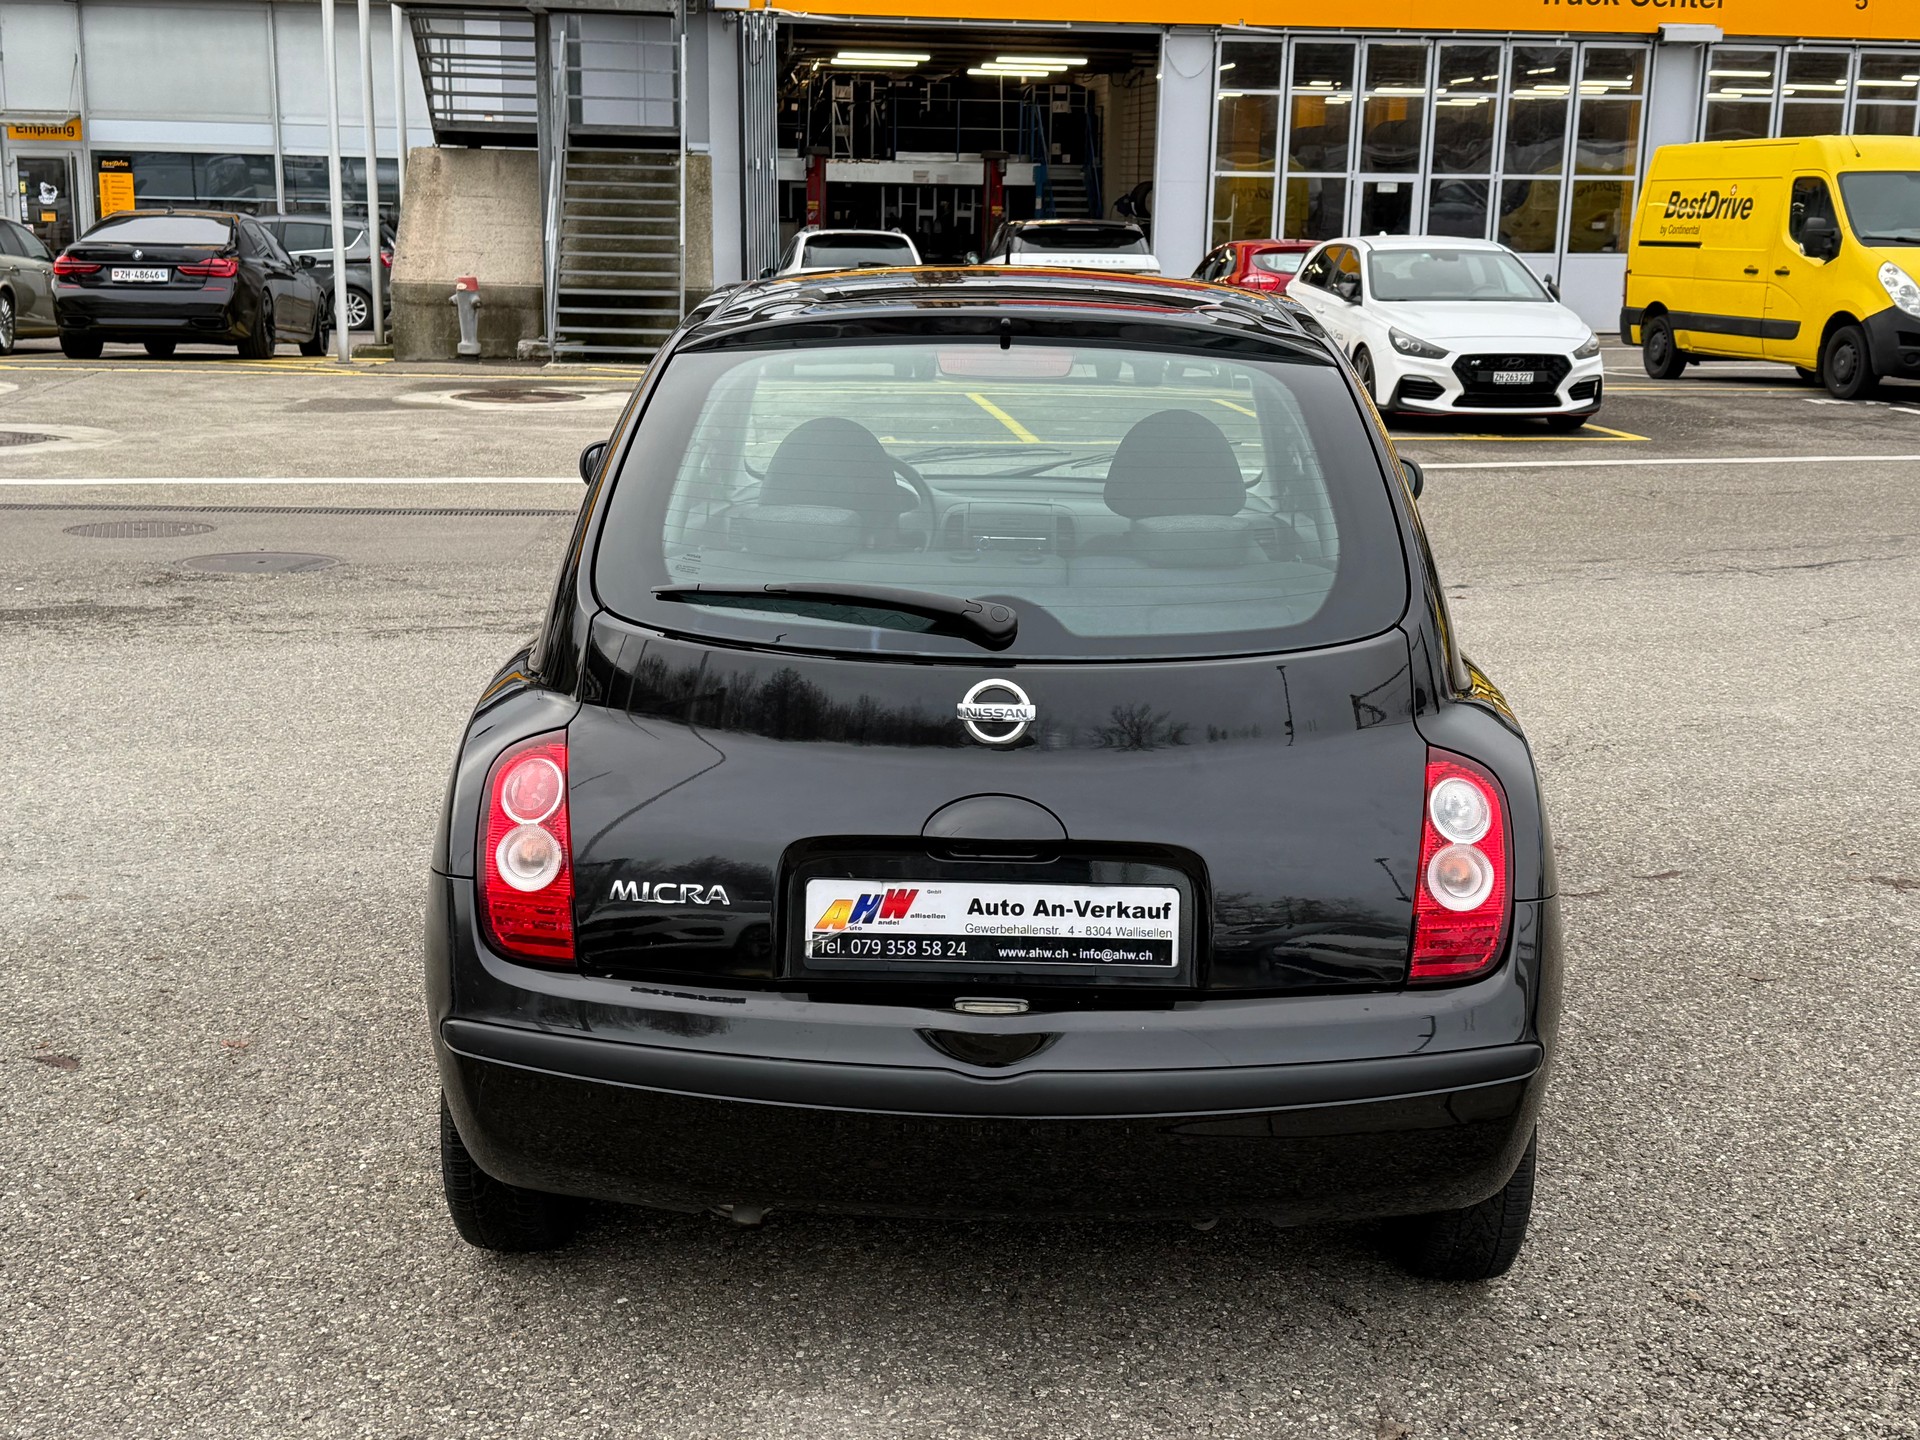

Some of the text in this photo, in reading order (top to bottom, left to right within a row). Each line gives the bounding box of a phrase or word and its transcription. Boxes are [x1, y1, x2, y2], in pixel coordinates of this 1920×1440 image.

[1664, 184, 1754, 220] BestDrive
[966, 707, 1027, 718] NISSAN
[609, 879, 731, 906] MICRA
[814, 888, 919, 930] AHW
[967, 898, 1172, 920] Auto An-Verkauf
[965, 923, 1061, 935] Gewerbehallenstr.
[1068, 926, 1075, 935] 4
[1085, 926, 1112, 936] 8304
[1115, 927, 1173, 938] Wallisellen
[820, 939, 967, 956] Tel. 079 358 58 24
[998, 947, 1069, 959] www.ahw.ch
[1079, 948, 1153, 962] info@ahw.ch
